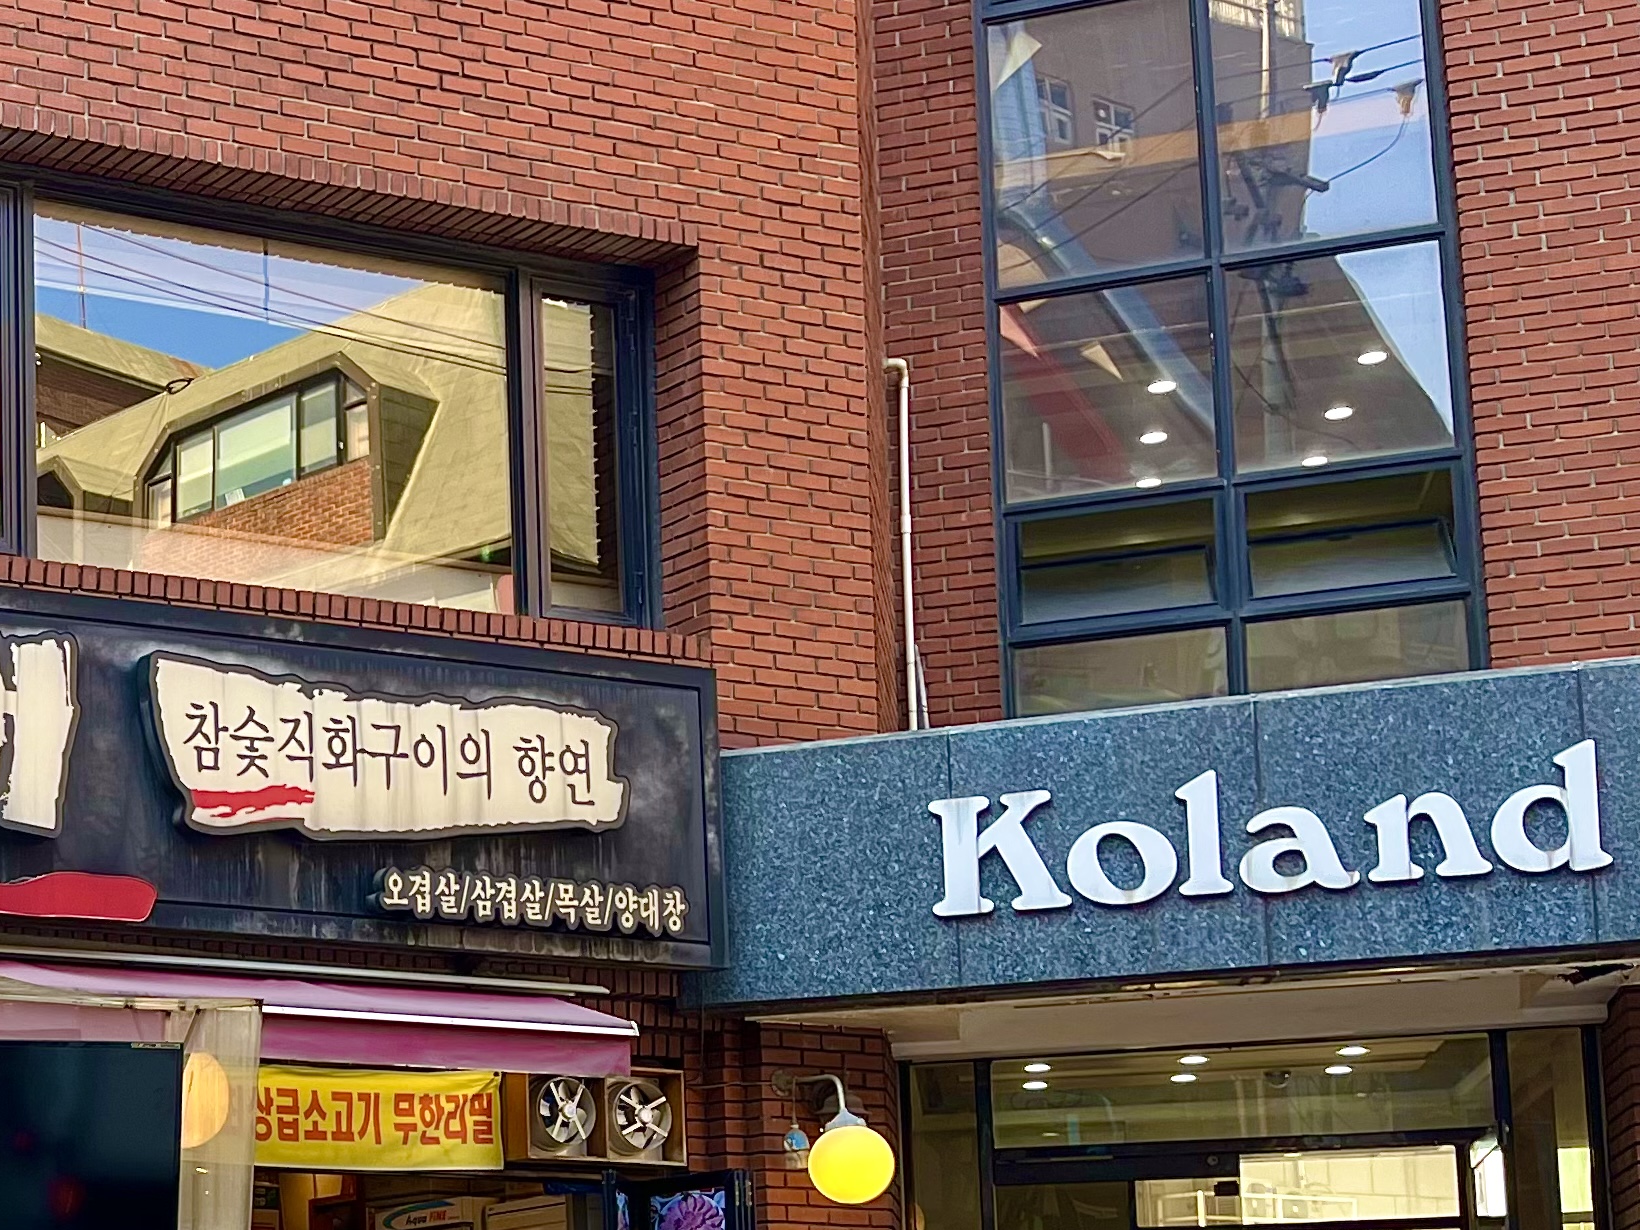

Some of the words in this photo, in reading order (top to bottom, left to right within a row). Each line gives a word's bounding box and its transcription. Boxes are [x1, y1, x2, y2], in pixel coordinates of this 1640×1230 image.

[182, 700, 493, 800] 참숯직화구이의
[512, 733, 596, 808] 향연
[927, 738, 1615, 918] Koland
[231, 1086, 382, 1145] 상급소고기
[393, 1092, 495, 1147] 무한리필
